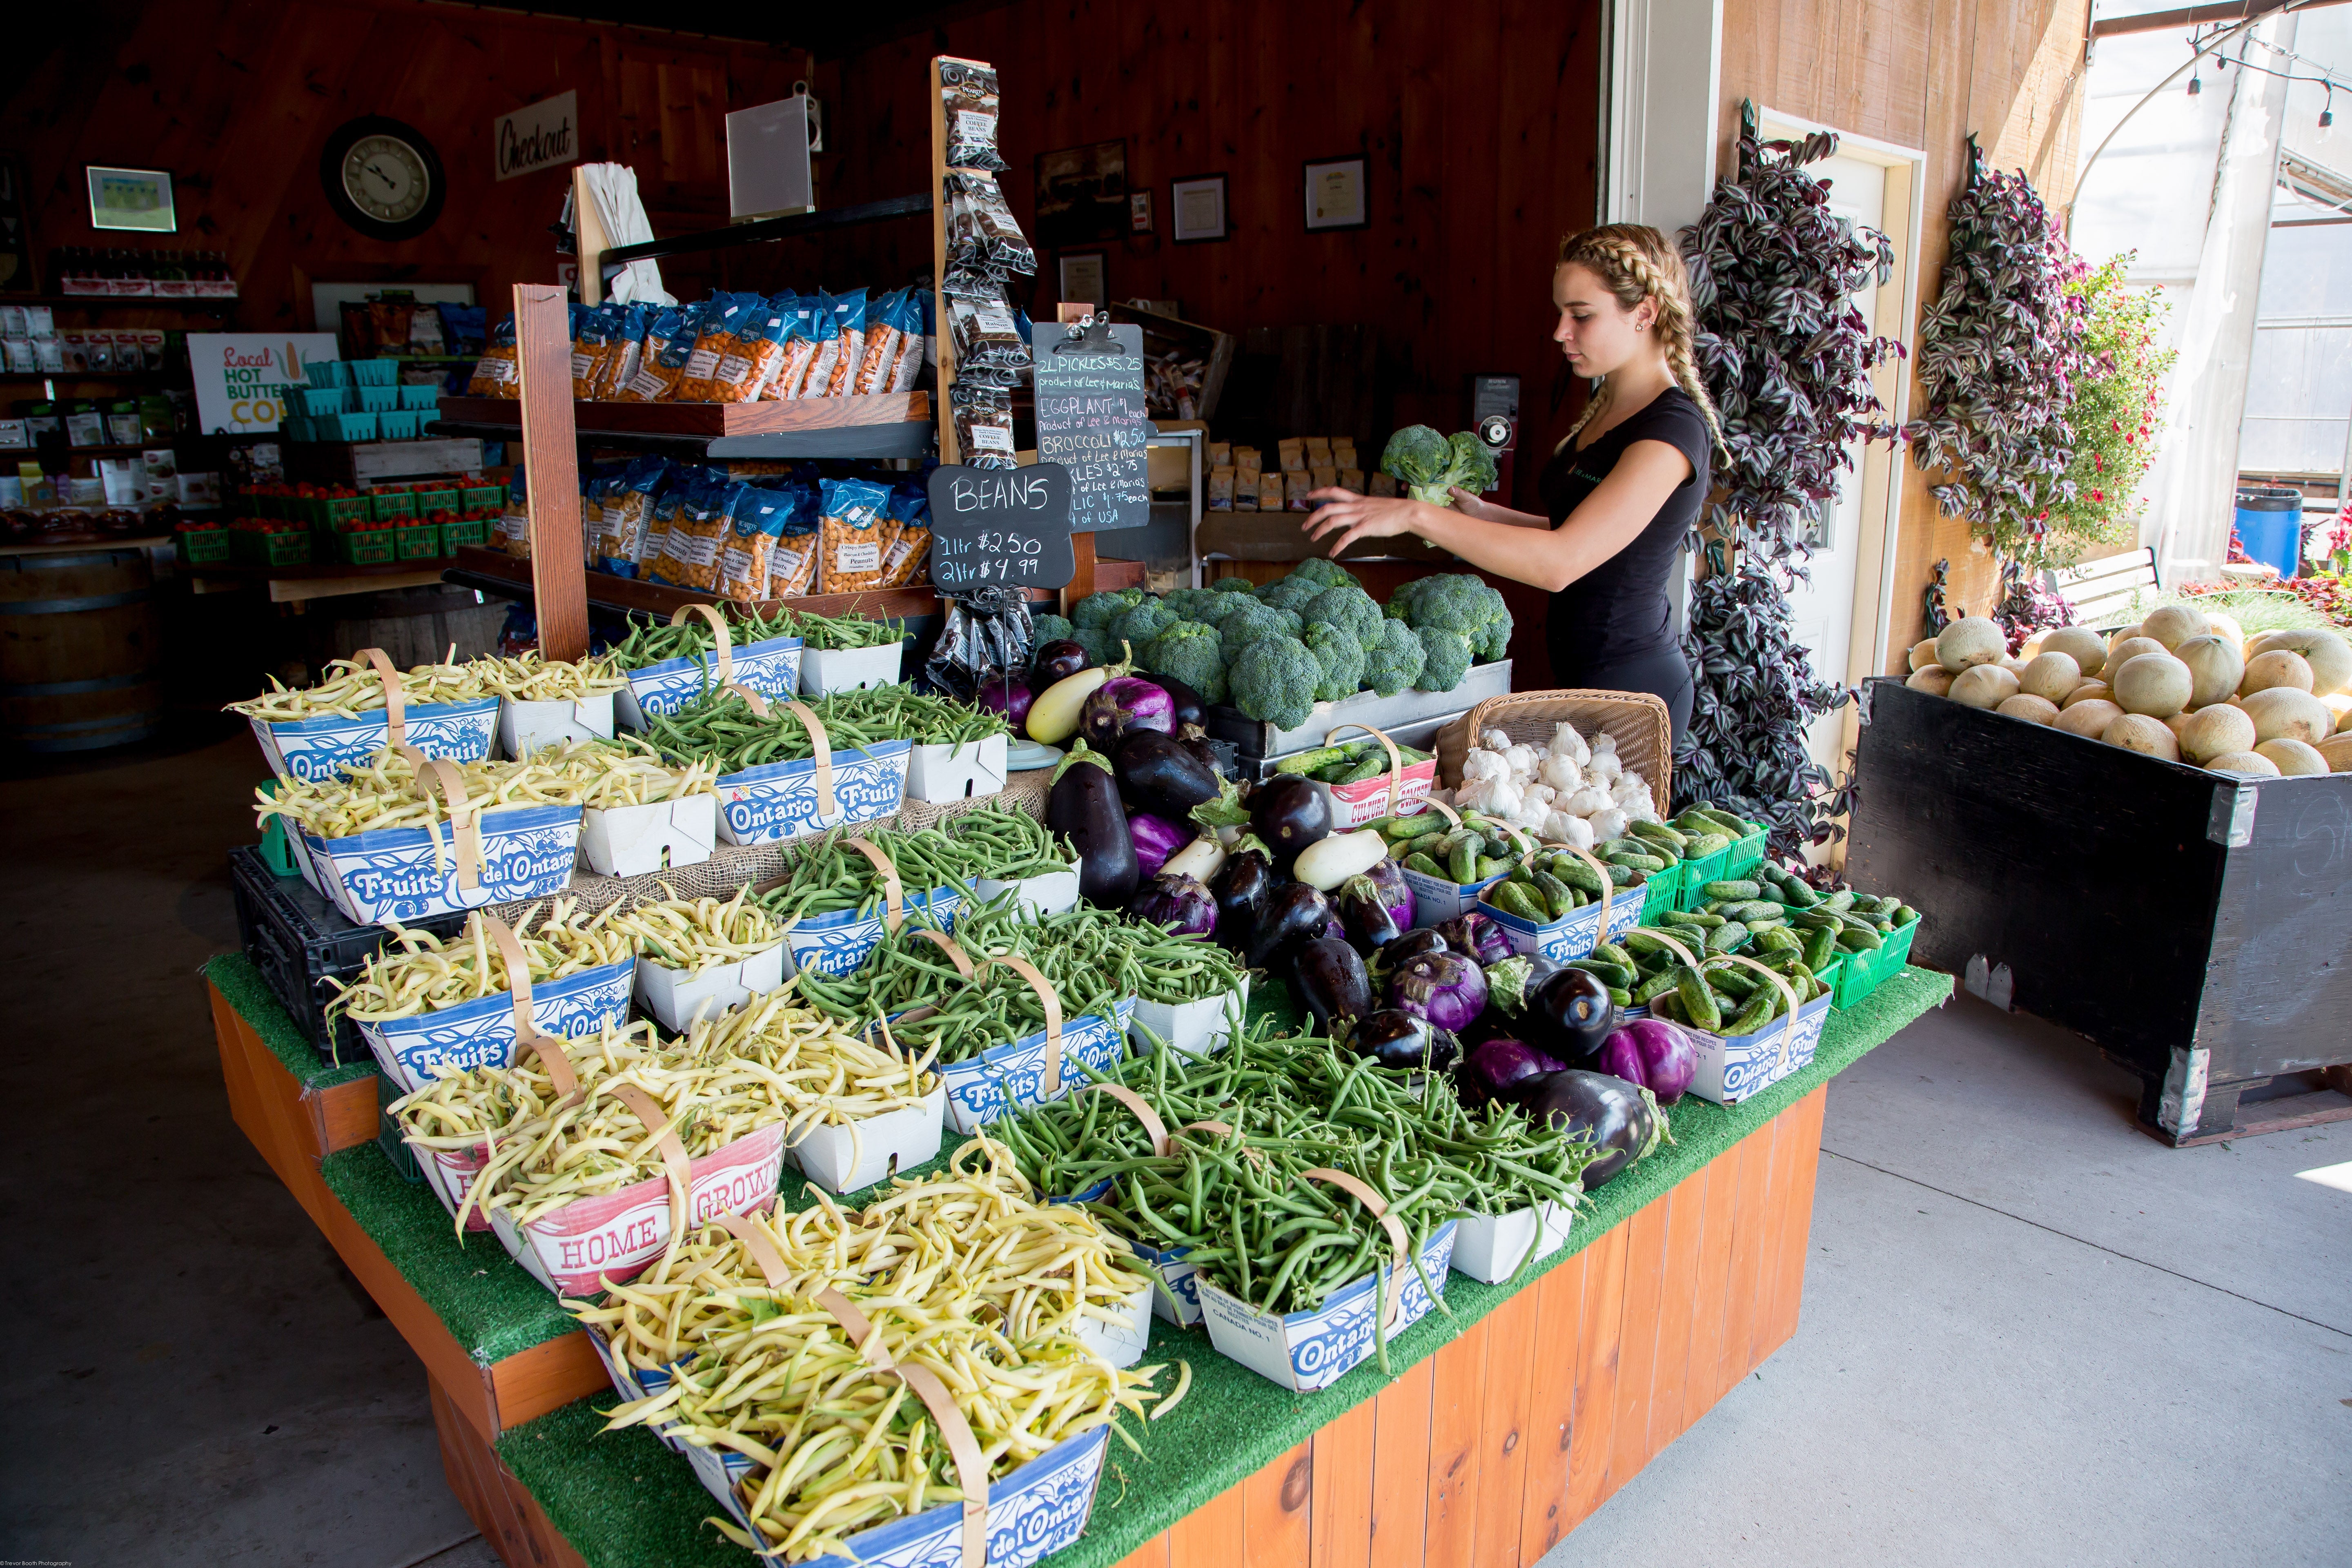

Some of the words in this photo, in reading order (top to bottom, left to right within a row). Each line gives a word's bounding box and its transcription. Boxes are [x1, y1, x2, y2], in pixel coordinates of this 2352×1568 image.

[961, 86, 984, 96] PICARD'S
[500, 117, 570, 175] Checkout
[224, 347, 273, 367] Local
[1038, 358, 1057, 374] 2L
[1058, 356, 1106, 372] PICKLES
[225, 368, 261, 383] HOT
[1039, 376, 1071, 394] product
[1074, 376, 1085, 387] of
[1085, 376, 1099, 387] Lee
[227, 384, 311, 399] BUTTE
[973, 405, 996, 413] PICARD'S
[1040, 397, 1112, 417] EGGPLANT
[1129, 409, 1145, 418] each
[1039, 417, 1071, 433] product
[1076, 416, 1085, 428] of
[1087, 417, 1100, 427] Lee
[1042, 434, 1111, 454] BROCCOLI
[1082, 450, 1092, 462] of
[1095, 451, 1109, 462] Lee
[950, 475, 1049, 512] BEANS
[1080, 483, 1089, 492] of
[1093, 482, 1107, 492] Lee
[1127, 494, 1148, 503] each
[1082, 511, 1092, 523] of
[1098, 509, 1118, 523] USA
[978, 532, 1041, 554] $2.50
[724, 562, 742, 572] Peanuts
[980, 558, 1038, 580] $4.99
[421, 739, 481, 762] Fruit
[731, 799, 814, 830] Ontario
[839, 782, 896, 808] Fruit
[1351, 796, 1385, 824] CULTURE
[354, 871, 443, 898] Fruits
[484, 865, 502, 884] de
[503, 851, 574, 882] l'Ontario
[1413, 891, 1431, 901] ANADA
[1419, 886, 1433, 895] RECETTES
[1550, 937, 1592, 960] Fruits
[800, 946, 871, 973] Ontari
[1701, 1036, 1717, 1046] RECIPES
[412, 1042, 503, 1074] Fruits
[1724, 1056, 1776, 1089] Ontario
[1791, 1033, 1820, 1059] Fruit
[559, 1215, 657, 1269] HOME
[696, 1156, 782, 1223] GROWN
[1213, 1309, 1247, 1332] CANADA
[1248, 1328, 1264, 1340] NO.
[1227, 1310, 1250, 1325] RECETTES
[1254, 1317, 1267, 1328] POUR
[1268, 1324, 1278, 1332] DES
[992, 1534, 1016, 1559] de
